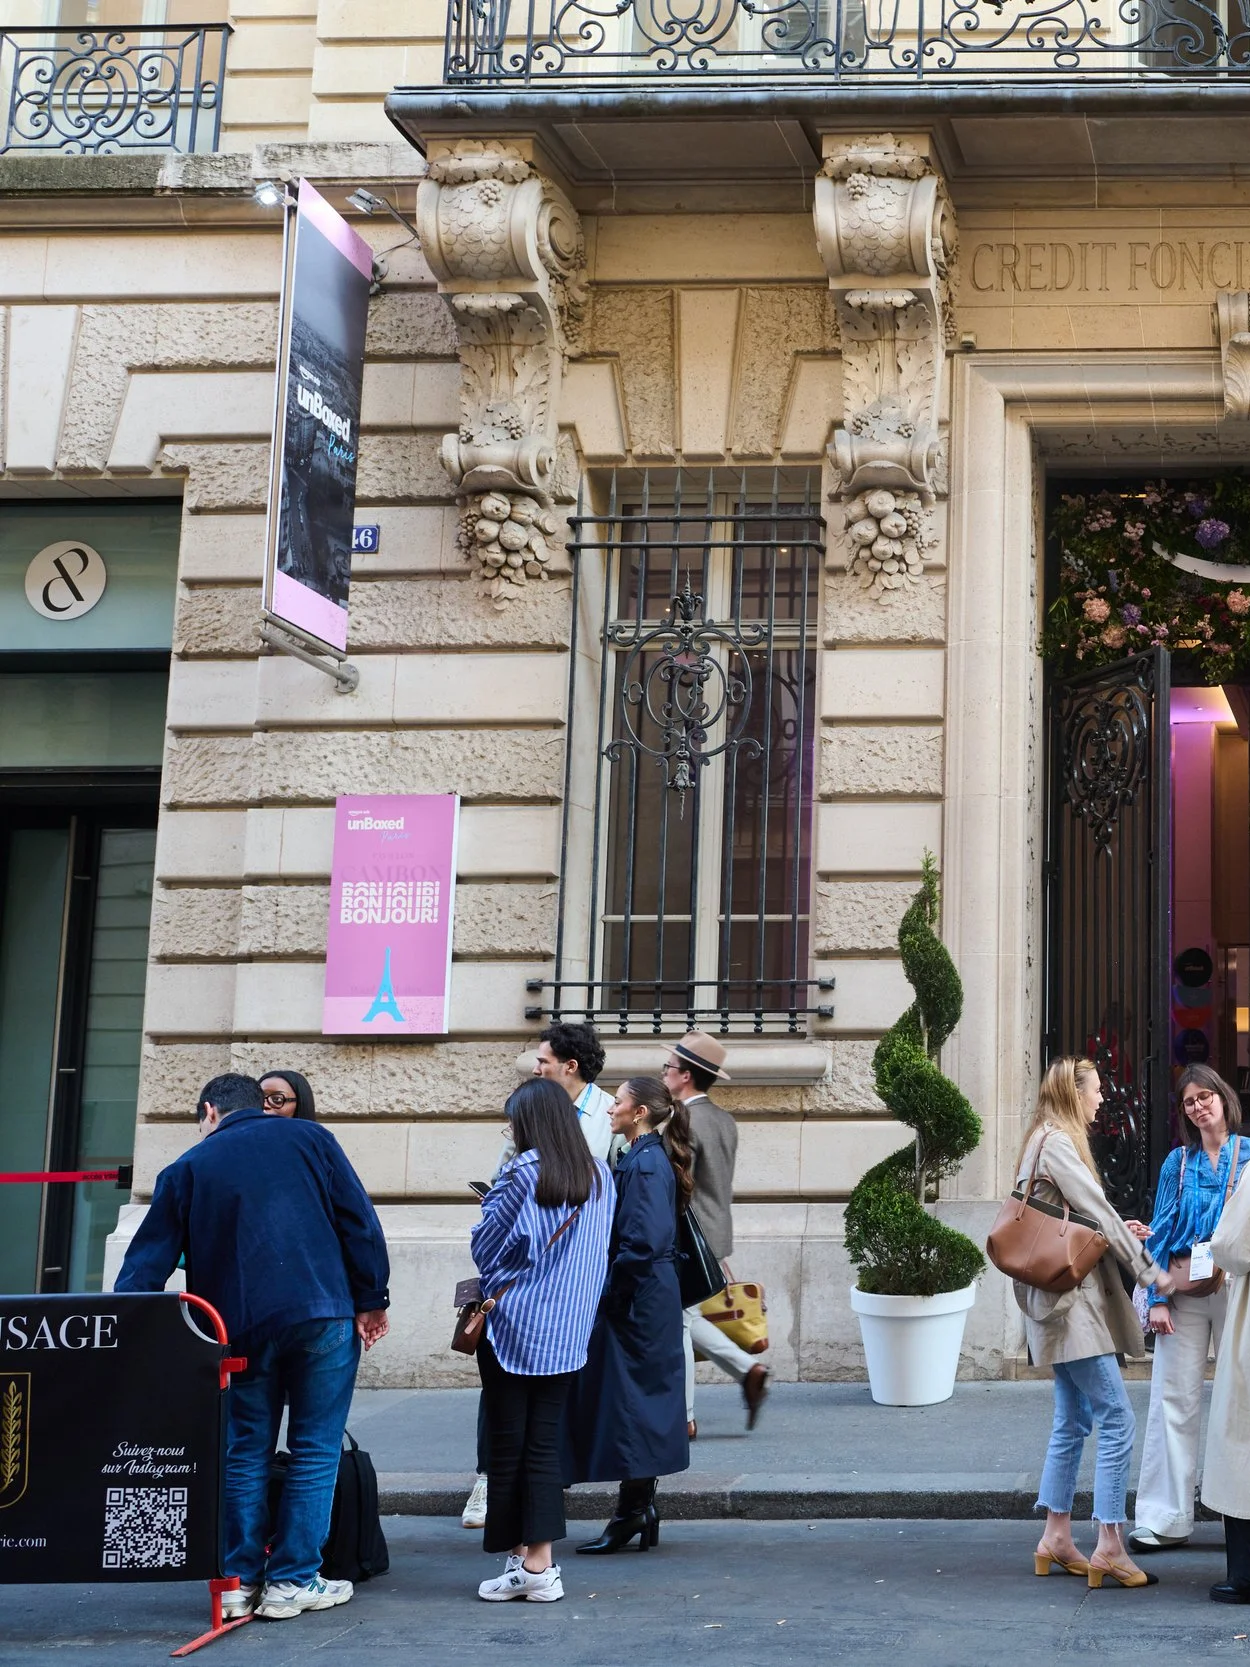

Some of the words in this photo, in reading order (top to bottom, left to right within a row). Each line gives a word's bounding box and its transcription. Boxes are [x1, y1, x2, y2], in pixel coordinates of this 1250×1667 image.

[969, 242, 1117, 292] CREDIT
[297, 384, 351, 443] unBoxed
[327, 433, 355, 464] Paris
[347, 816, 404, 831] unBoxed
[340, 907, 439, 925] BONJOUR!
[0, 1314, 119, 1351] SAGE
[112, 1441, 186, 1462] Suivez-nous
[101, 1463, 123, 1474] sur
[122, 1459, 192, 1480] Instagram
[0, 1533, 47, 1548] ie.com
